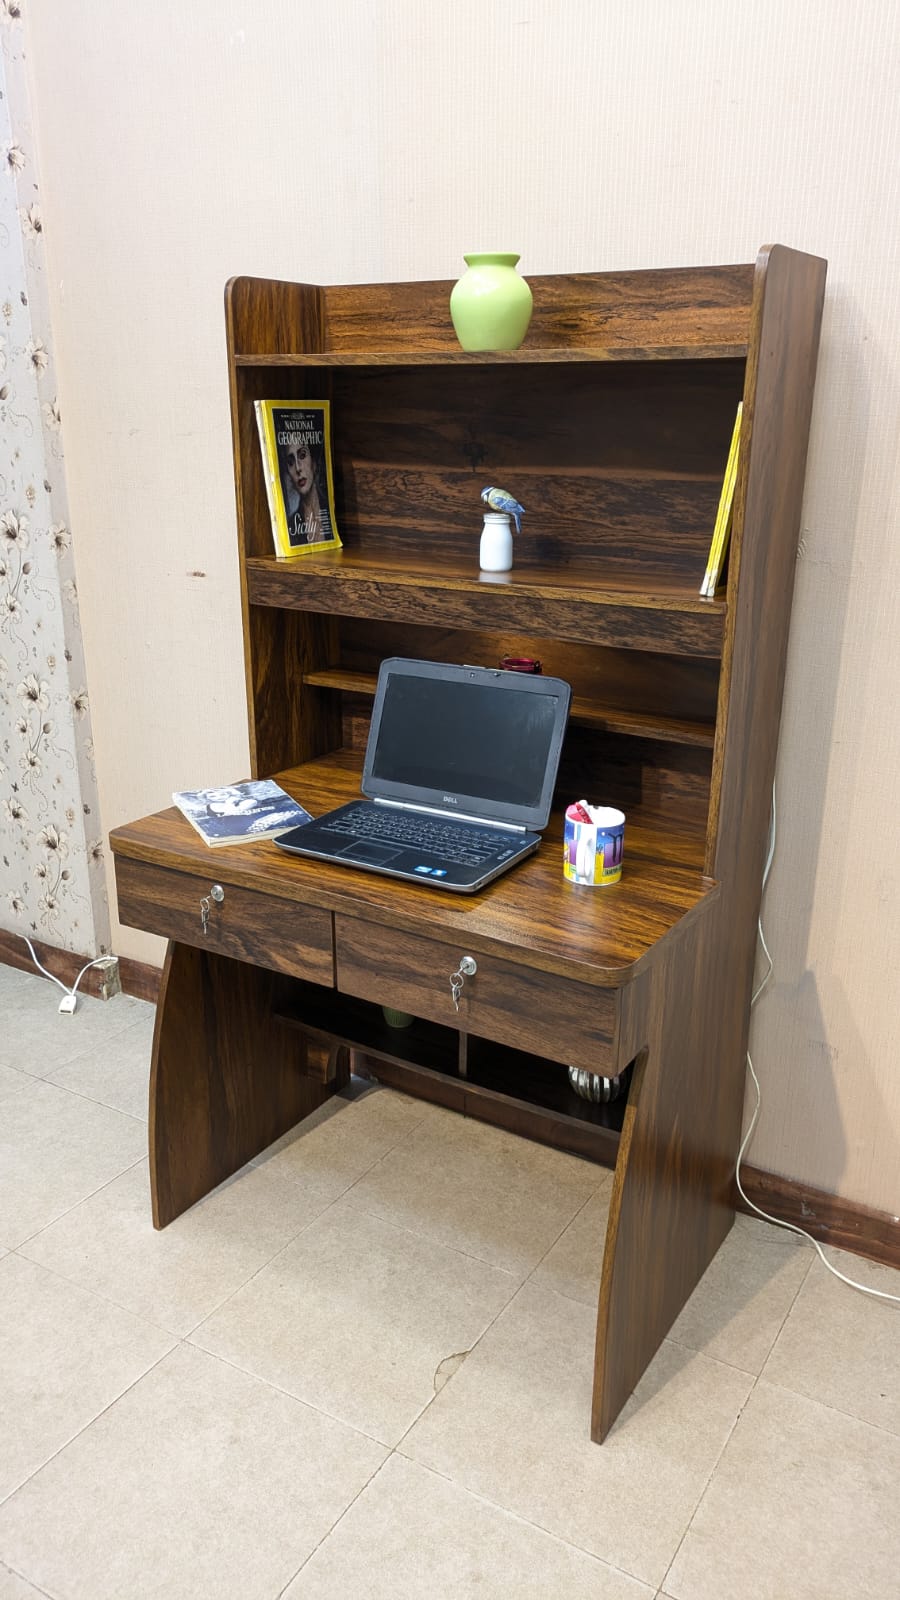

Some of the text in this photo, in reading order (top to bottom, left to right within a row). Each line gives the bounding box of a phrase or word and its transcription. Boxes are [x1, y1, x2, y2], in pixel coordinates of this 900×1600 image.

[284, 420, 314, 430] NATIONAL
[277, 431, 322, 445] GEOGRAPHIC
[289, 512, 317, 541] Sicily
[443, 796, 458, 804] DELL
